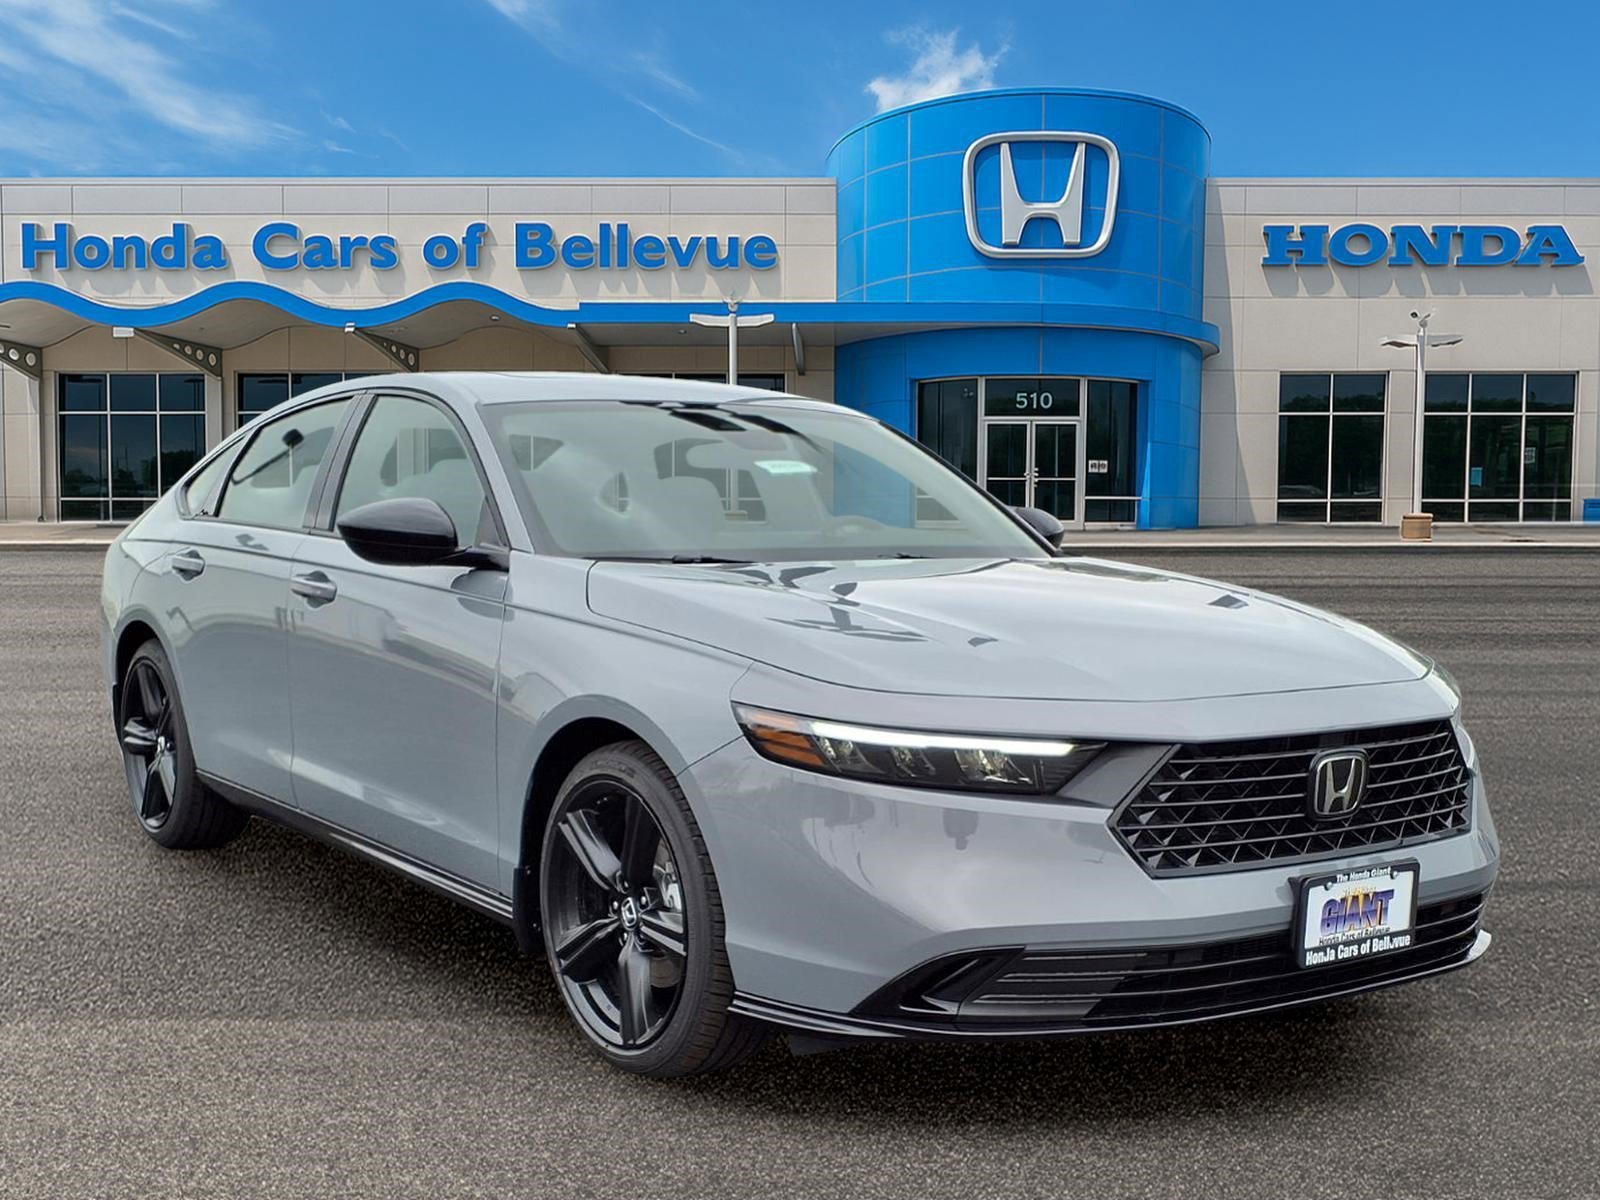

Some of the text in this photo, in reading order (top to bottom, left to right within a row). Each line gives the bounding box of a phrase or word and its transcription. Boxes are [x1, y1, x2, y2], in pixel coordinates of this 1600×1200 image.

[21, 222, 778, 271] Honda Cars of Bellevue
[1262, 224, 1585, 267] HONDA
[1015, 392, 1053, 409] 510
[1320, 889, 1395, 935] GIANT
[1337, 944, 1359, 960] Cars
[1360, 939, 1371, 955] of
